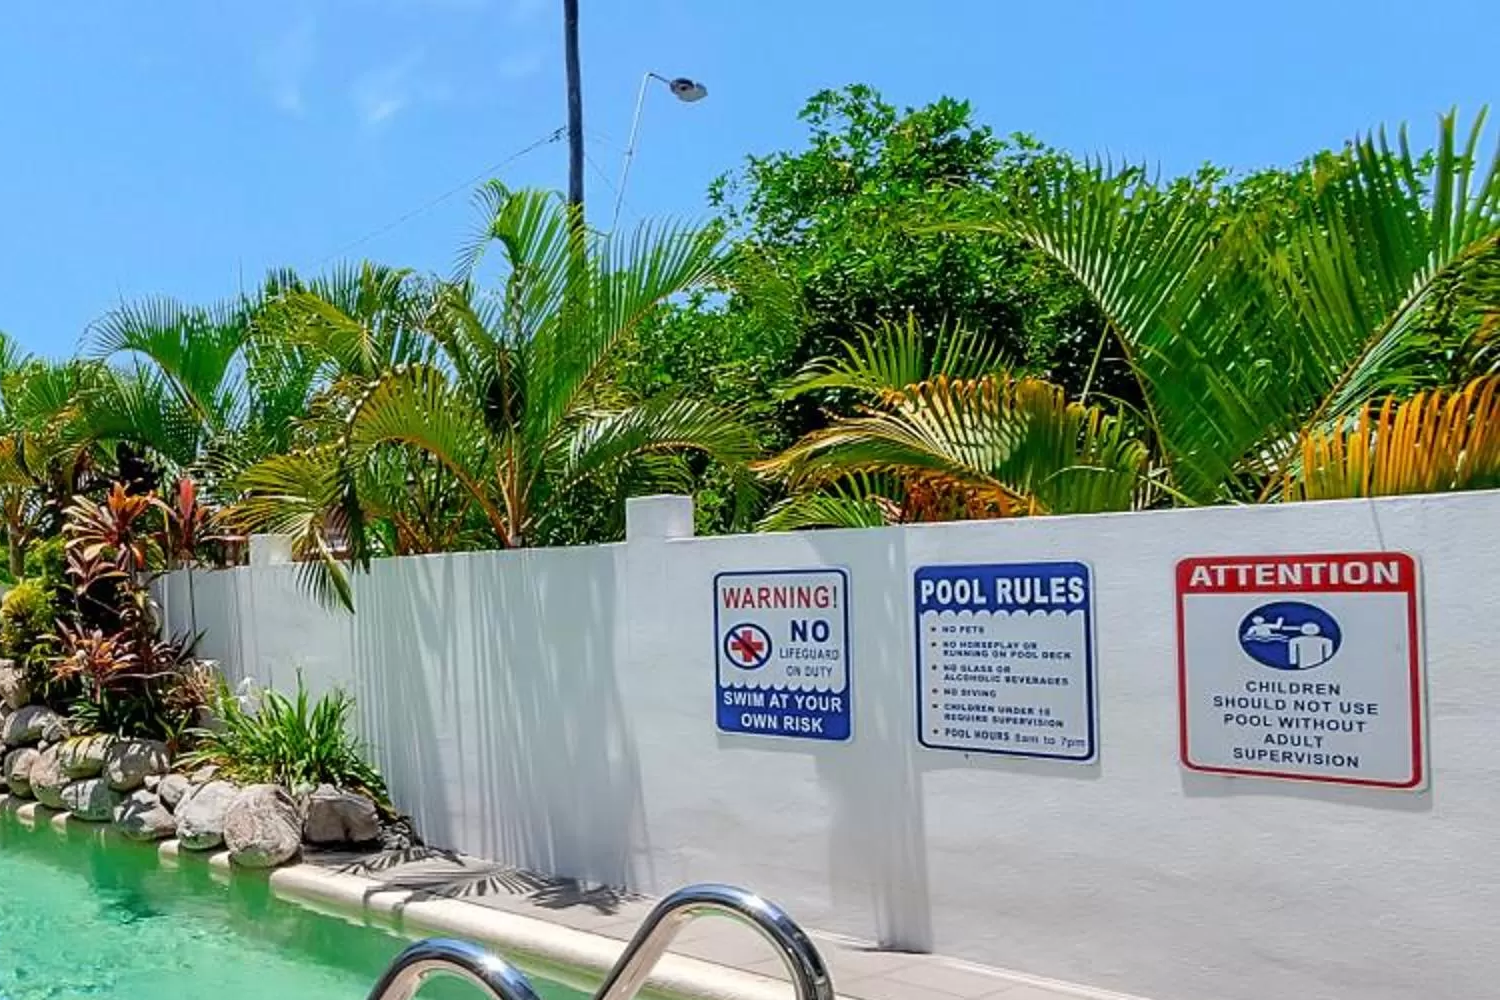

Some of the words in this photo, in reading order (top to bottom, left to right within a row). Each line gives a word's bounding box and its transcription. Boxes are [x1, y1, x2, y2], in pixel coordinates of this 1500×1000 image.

[1189, 561, 1400, 587] ATTENTION
[722, 586, 837, 609] WARNING!
[921, 578, 987, 605] POOL
[996, 577, 1085, 605] RULES
[791, 620, 830, 642] NO
[942, 625, 957, 634] NO
[960, 625, 985, 634] PETS
[943, 641, 957, 649] NO
[960, 641, 1019, 649] HORSEPLAY
[1023, 642, 1037, 650] OR
[780, 648, 839, 660] LIFEGUARD
[943, 650, 989, 658] RUNNING
[1010, 651, 1039, 659] POOL
[1041, 651, 1072, 659] DECK
[786, 665, 801, 677] ON
[805, 665, 832, 677] DUTY
[943, 664, 957, 672] NO
[960, 665, 993, 673] GLASS
[996, 665, 1011, 673] OR
[943, 674, 1000, 682] ALCOHOLIC
[1004, 676, 1069, 685] BEVERAGES
[943, 688, 958, 696] NO
[961, 688, 997, 698] DIVING
[1245, 680, 1341, 697] CHILDREN
[723, 691, 764, 706] SWIM
[769, 693, 789, 709] AT
[794, 695, 843, 712] YOUR
[943, 703, 995, 713] CHILDREN
[997, 706, 1035, 715] UNDER
[1213, 695, 1287, 711] SHOULD
[1293, 699, 1332, 713] NOT
[1339, 701, 1379, 715] USE
[741, 713, 778, 729] OWN
[783, 715, 823, 733] RISK
[943, 713, 988, 722] REQUIRE
[991, 715, 1064, 728] SUPERVISION
[1223, 713, 1272, 727] POOL
[1278, 716, 1367, 733] WITHOUT
[945, 728, 971, 739] POOL
[974, 730, 1010, 741] HOURS
[1043, 735, 1056, 745] to
[1263, 734, 1324, 748] ADULT
[1233, 748, 1359, 768] SUPERVISION
